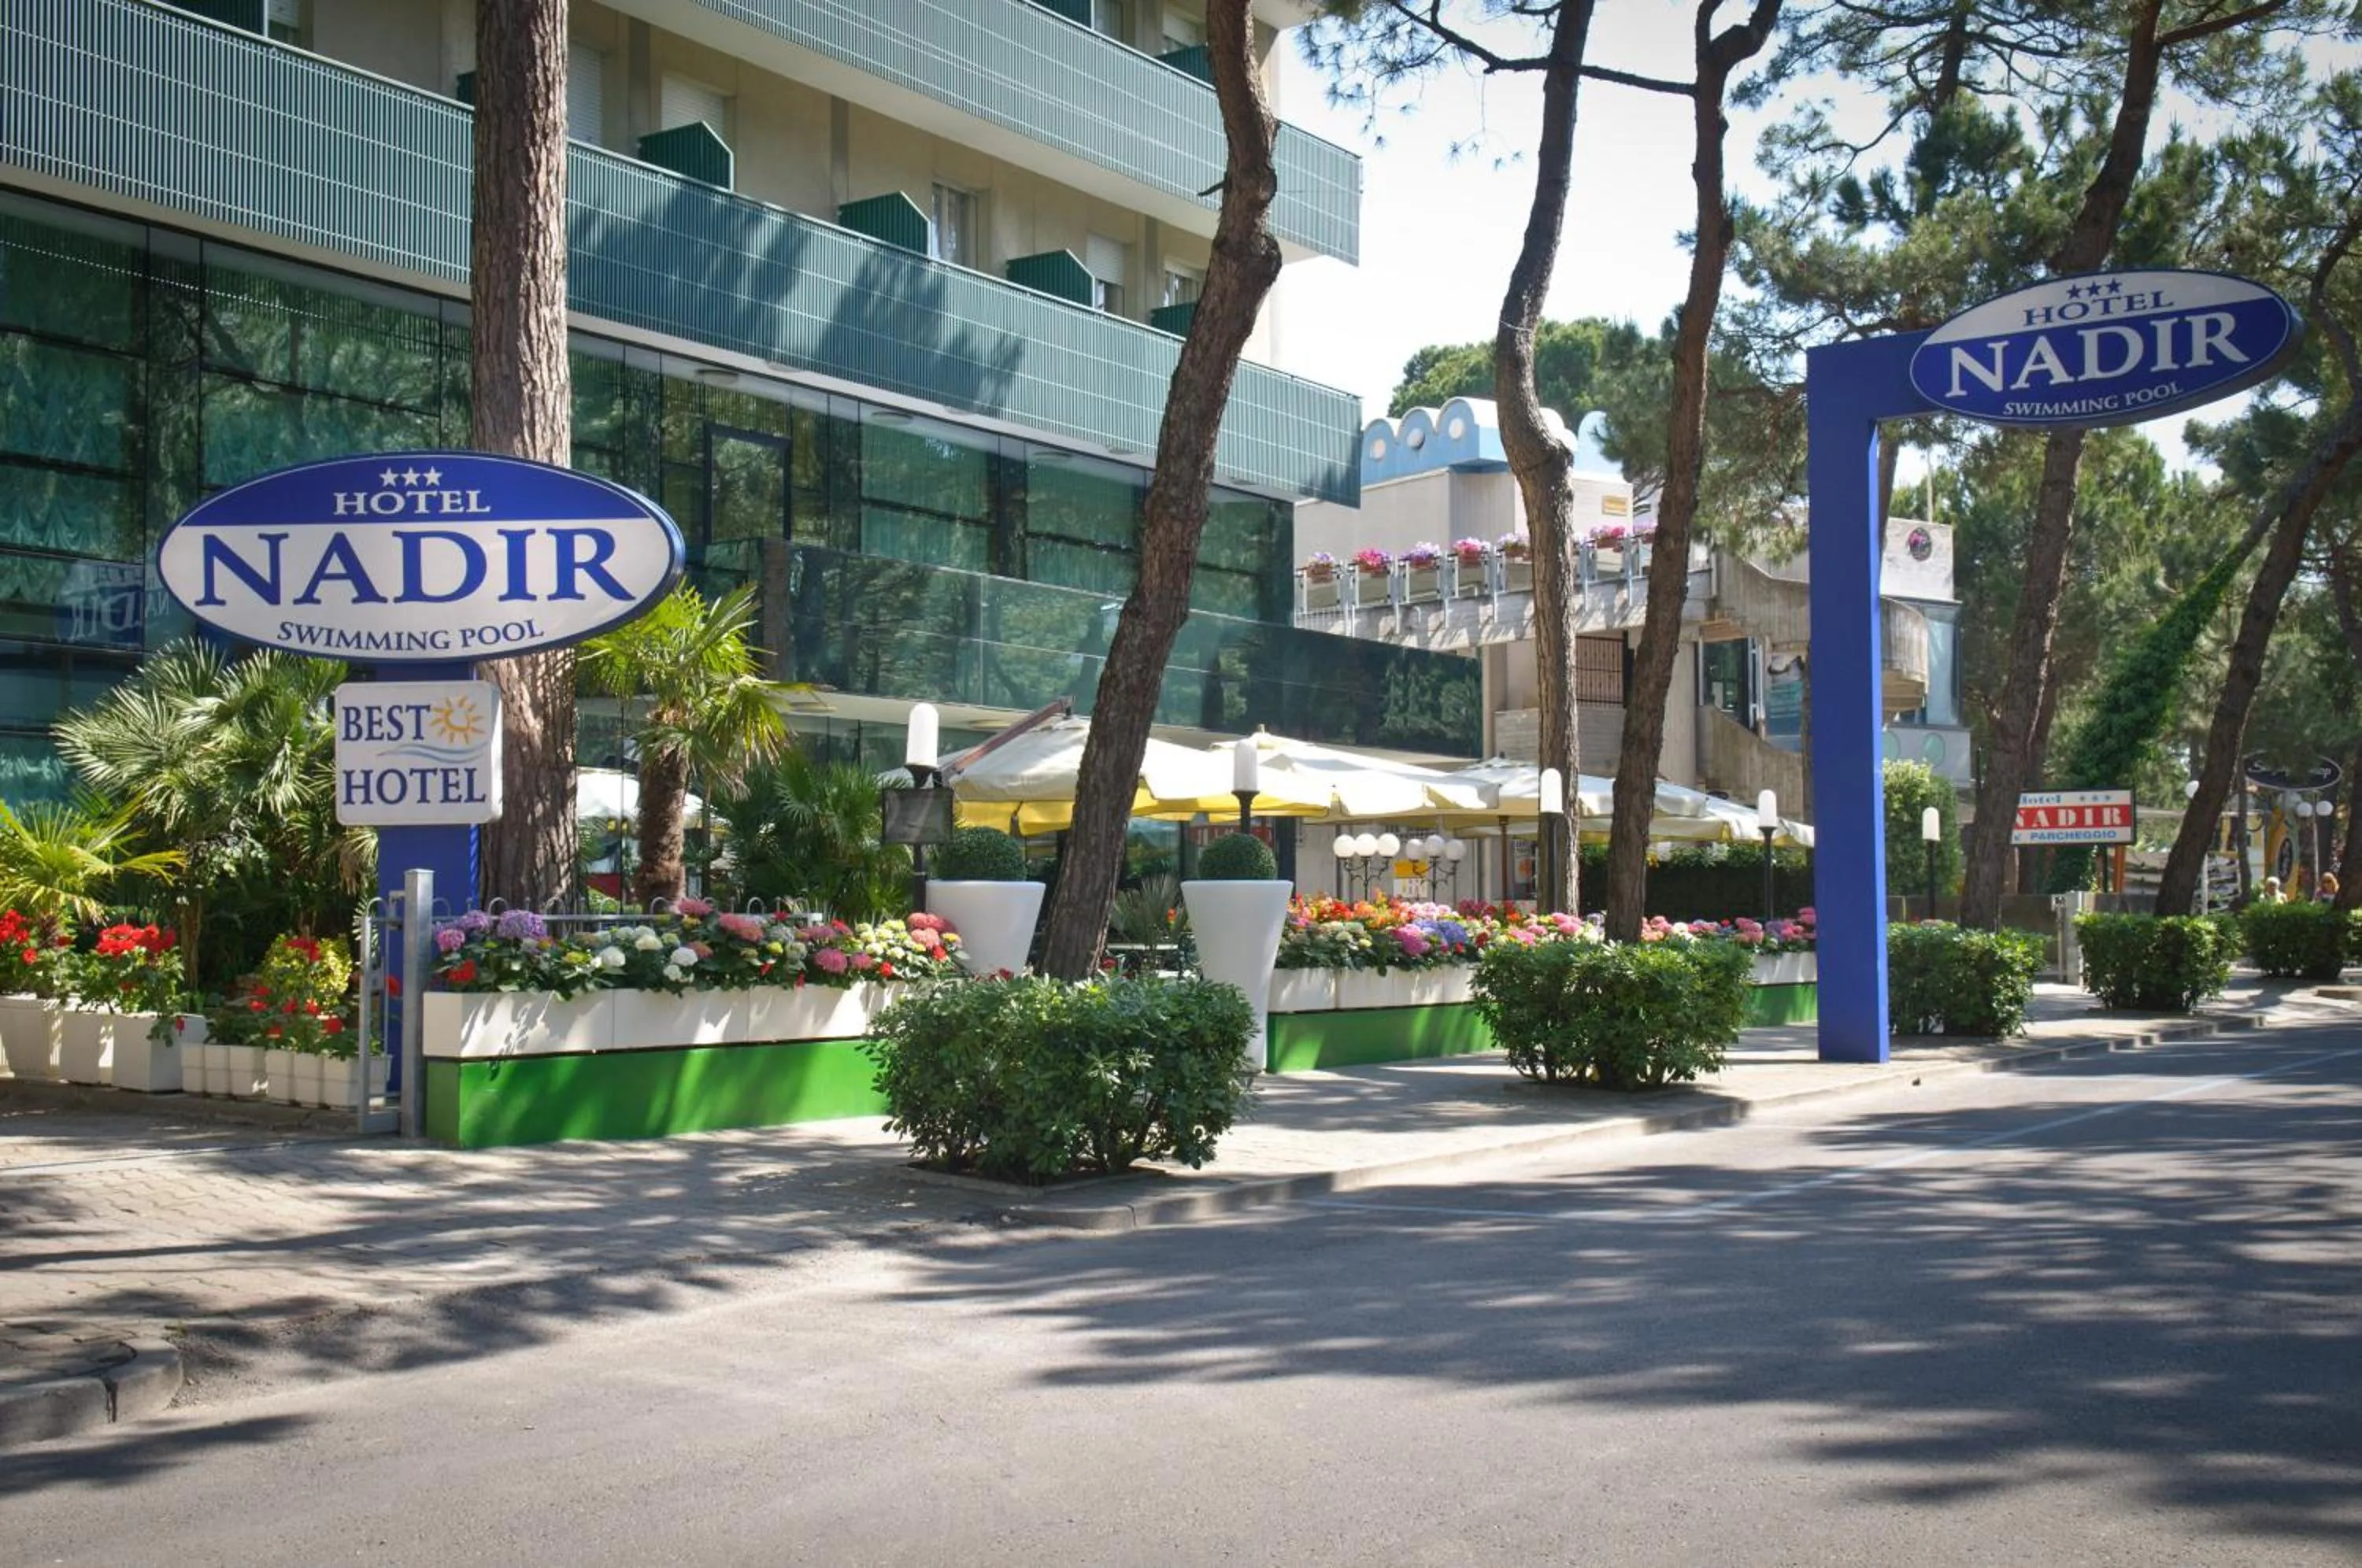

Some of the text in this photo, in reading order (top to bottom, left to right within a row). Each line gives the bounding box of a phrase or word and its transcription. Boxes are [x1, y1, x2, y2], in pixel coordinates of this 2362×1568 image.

[2023, 290, 2174, 327] HOTEL
[1945, 312, 2250, 398] NADIR
[2002, 381, 2183, 417] SWIMMING POOL
[333, 489, 491, 516] HOTEL
[194, 527, 636, 608] NADIR
[276, 619, 544, 652] SWIMMING POOL
[341, 704, 431, 742] BEST
[341, 767, 487, 805] HOTEL
[2030, 830, 2117, 841] PARCHEGGIO
